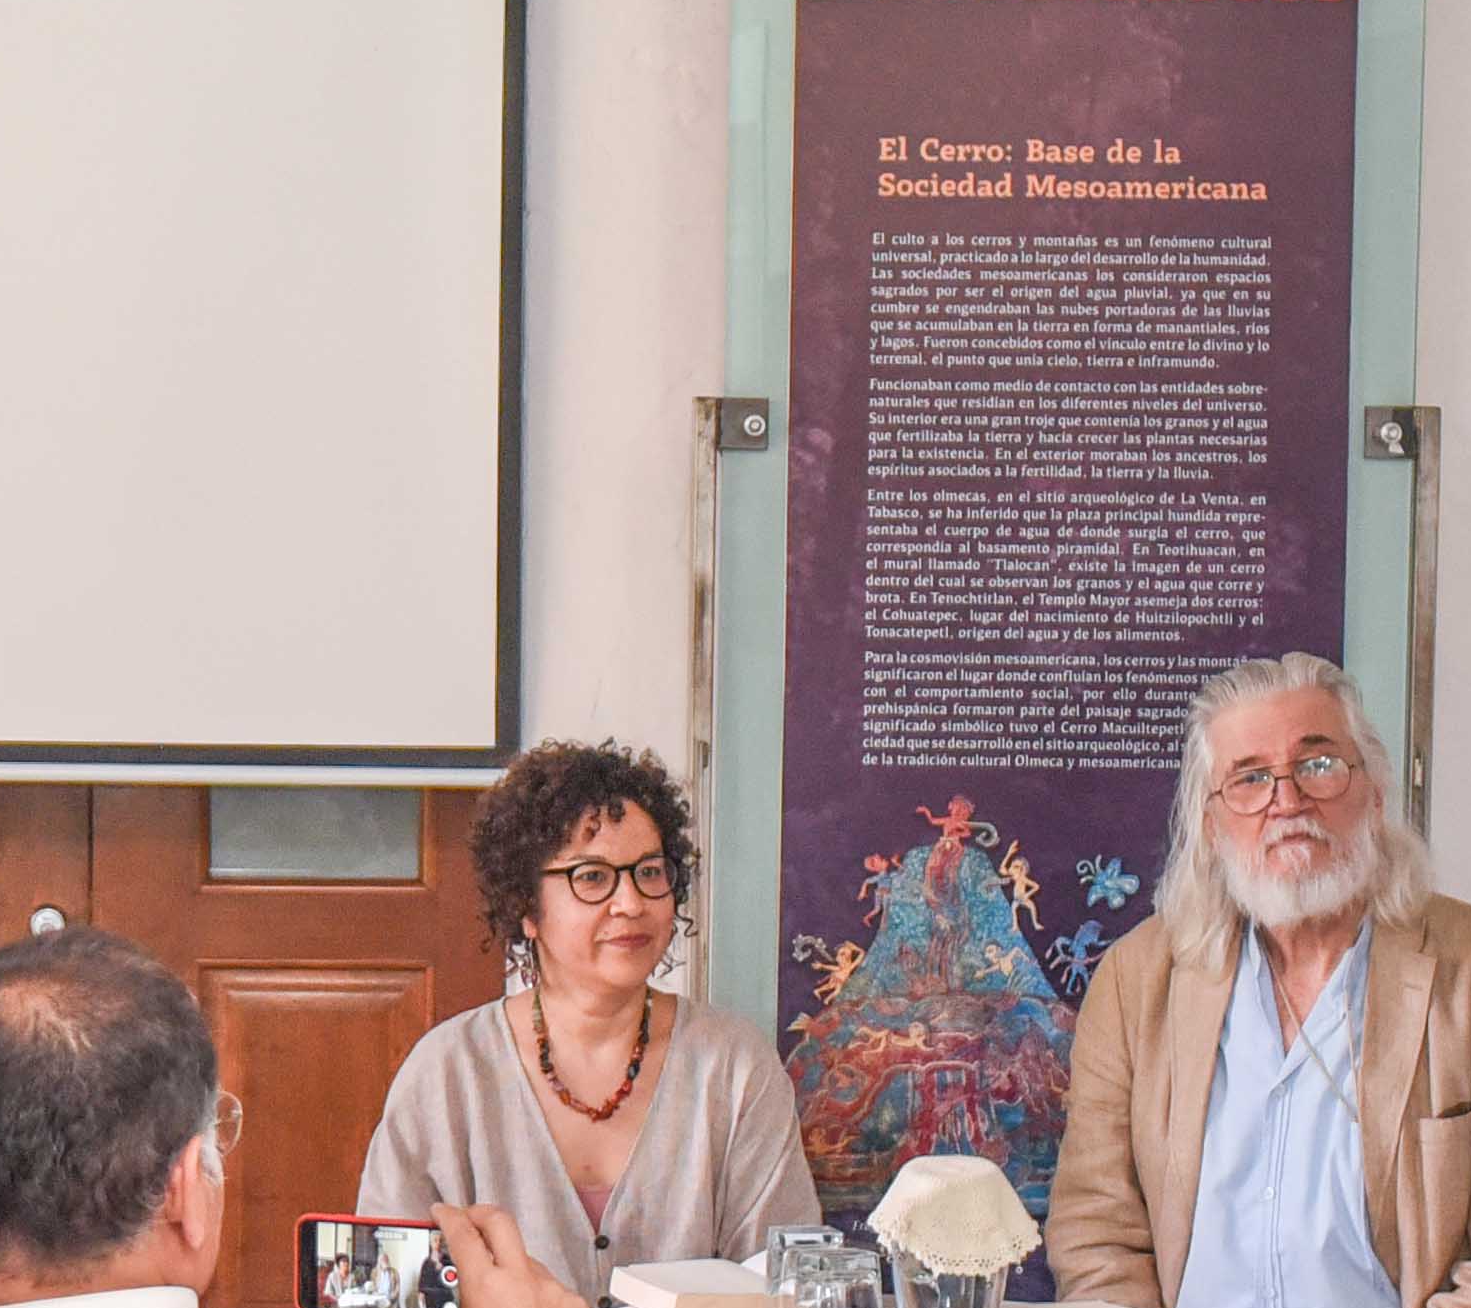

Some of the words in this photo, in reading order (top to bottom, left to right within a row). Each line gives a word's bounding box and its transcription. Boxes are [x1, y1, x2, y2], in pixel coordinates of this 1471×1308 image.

[878, 137, 907, 162] El
[920, 138, 1013, 163] Cerro:
[1026, 139, 1095, 164] Base
[1106, 139, 1142, 164] de
[1153, 139, 1182, 164] la
[877, 172, 1013, 198] Sociedad
[1026, 174, 1268, 201] Mesoamericana
[872, 231, 885, 245] El
[892, 231, 924, 245] culto
[931, 236, 939, 245] a
[946, 232, 964, 246] los
[971, 236, 1012, 246] cerros
[1019, 237, 1026, 249] y
[1033, 233, 1098, 247] montañas
[1104, 237, 1119, 247] es
[1125, 238, 1142, 247] un
[1150, 234, 1214, 248] fenómeno
[1221, 235, 1272, 249] cultural
[872, 265, 893, 279] Las
[901, 265, 971, 280] sociedades
[980, 266, 1088, 281] mesoamericanas
[1096, 267, 1114, 281] los
[1123, 268, 1208, 282] consideraron
[1216, 269, 1271, 286] espacios
[871, 282, 928, 300] sagrados
[936, 287, 957, 300] por
[965, 287, 984, 298] ser
[992, 283, 1004, 298] el
[1010, 283, 1052, 301] origen
[1059, 284, 1079, 299] del
[1086, 288, 1117, 302] agua
[1124, 285, 1172, 303] pluvial,
[1181, 289, 1196, 303] ya
[1202, 290, 1226, 303] que
[1233, 290, 1249, 301] en
[1256, 290, 1271, 301] su
[870, 299, 920, 313] cumbre
[926, 303, 939, 313] se
[945, 300, 1030, 317] engendraban
[1036, 301, 1054, 314] las
[1061, 301, 1099, 315] nubes
[1105, 301, 1176, 319] portadoras
[1182, 302, 1198, 316] de
[1204, 303, 1222, 316] las
[1228, 303, 1270, 317] lluvias
[870, 351, 926, 366] terrenal,
[932, 352, 943, 365] el
[947, 352, 985, 369] punto
[988, 356, 1012, 369] que
[1015, 352, 1044, 366] unía
[1047, 353, 1082, 368] cielo,
[1087, 353, 1124, 367] tierra
[1127, 358, 1135, 367] e
[1138, 354, 1218, 368] inframundo.
[869, 394, 930, 408] naturales
[934, 399, 958, 411] que
[962, 395, 1014, 409] residían
[1019, 400, 1034, 409] en
[1039, 396, 1057, 410] los
[1061, 396, 1128, 410] diferentes
[1132, 397, 1178, 411] niveles
[1182, 397, 1202, 411] del
[1206, 398, 1266, 412] universo.
[868, 432, 892, 445] que
[896, 428, 963, 442] fertilizaba
[968, 429, 980, 443] la
[985, 429, 1022, 443] tierra
[1026, 434, 1034, 446] y
[1039, 430, 1073, 444] hacía
[1078, 434, 1117, 444] crecer
[1123, 431, 1141, 444] las
[1146, 431, 1194, 448] plantas
[1199, 431, 1268, 446] necesarias
[868, 449, 897, 462] para
[902, 445, 914, 459] la
[918, 445, 988, 460] existencia.
[995, 446, 1012, 460] En
[1016, 446, 1028, 460] el
[1033, 447, 1084, 461] exterior
[1090, 447, 1147, 462] moraban
[1152, 448, 1171, 462] los
[1176, 448, 1242, 464] ancestros,
[1248, 449, 1267, 463] los
[867, 487, 904, 502] Entre
[909, 487, 928, 502] los
[933, 488, 990, 504] olmecas,
[997, 492, 1013, 503] en
[1018, 488, 1030, 503] el
[1036, 489, 1065, 504] sitio
[1070, 489, 1154, 508] arqueológico
[1159, 490, 1175, 505] de
[1181, 490, 1196, 505] La
[1201, 491, 1243, 507] Venta,
[1250, 495, 1266, 506] en
[866, 522, 918, 536] sentaba
[925, 522, 937, 536] el
[944, 527, 989, 540] cuerpo
[996, 523, 1012, 537] de
[1019, 528, 1050, 540] agua
[1057, 524, 1073, 538] de
[1080, 524, 1120, 538] donde
[1128, 525, 1168, 542] surgía
[1175, 525, 1188, 539] el
[1195, 529, 1233, 540] cerro,
[1242, 530, 1266, 543] que
[866, 539, 952, 556] correspondía
[958, 540, 970, 554] al
[978, 540, 1050, 554] basamento
[1056, 541, 1124, 558] piramidal.
[1132, 542, 1150, 556] En
[1158, 542, 1240, 558] Teotihuacan,
[1249, 547, 1265, 557] en
[866, 556, 878, 570] el
[884, 556, 922, 570] mural
[928, 557, 980, 571] llamado
[987, 557, 1062, 573] "Tlalocan",
[1068, 558, 1108, 572] existe
[1114, 559, 1126, 572] la
[1132, 559, 1180, 576] imagen
[1186, 559, 1202, 573] de
[1208, 564, 1224, 573] un
[1230, 564, 1265, 574] cerro
[864, 607, 876, 621] el
[882, 607, 962, 624] Cohuatepec,
[970, 608, 1003, 625] lugar
[1009, 608, 1029, 622] del
[1035, 609, 1108, 623] nacimiento
[1114, 610, 1130, 623] de
[1136, 610, 1233, 627] Huitzilopochtli
[1239, 615, 1246, 628] y
[1252, 611, 1264, 625] el
[863, 717, 936, 735] significado
[941, 718, 1004, 733] simbólico
[1009, 718, 1038, 733] tuvo
[1043, 719, 1055, 733] el
[1060, 719, 1097, 734] Cerro
[1102, 719, 1184, 738] Macuiltepetl
